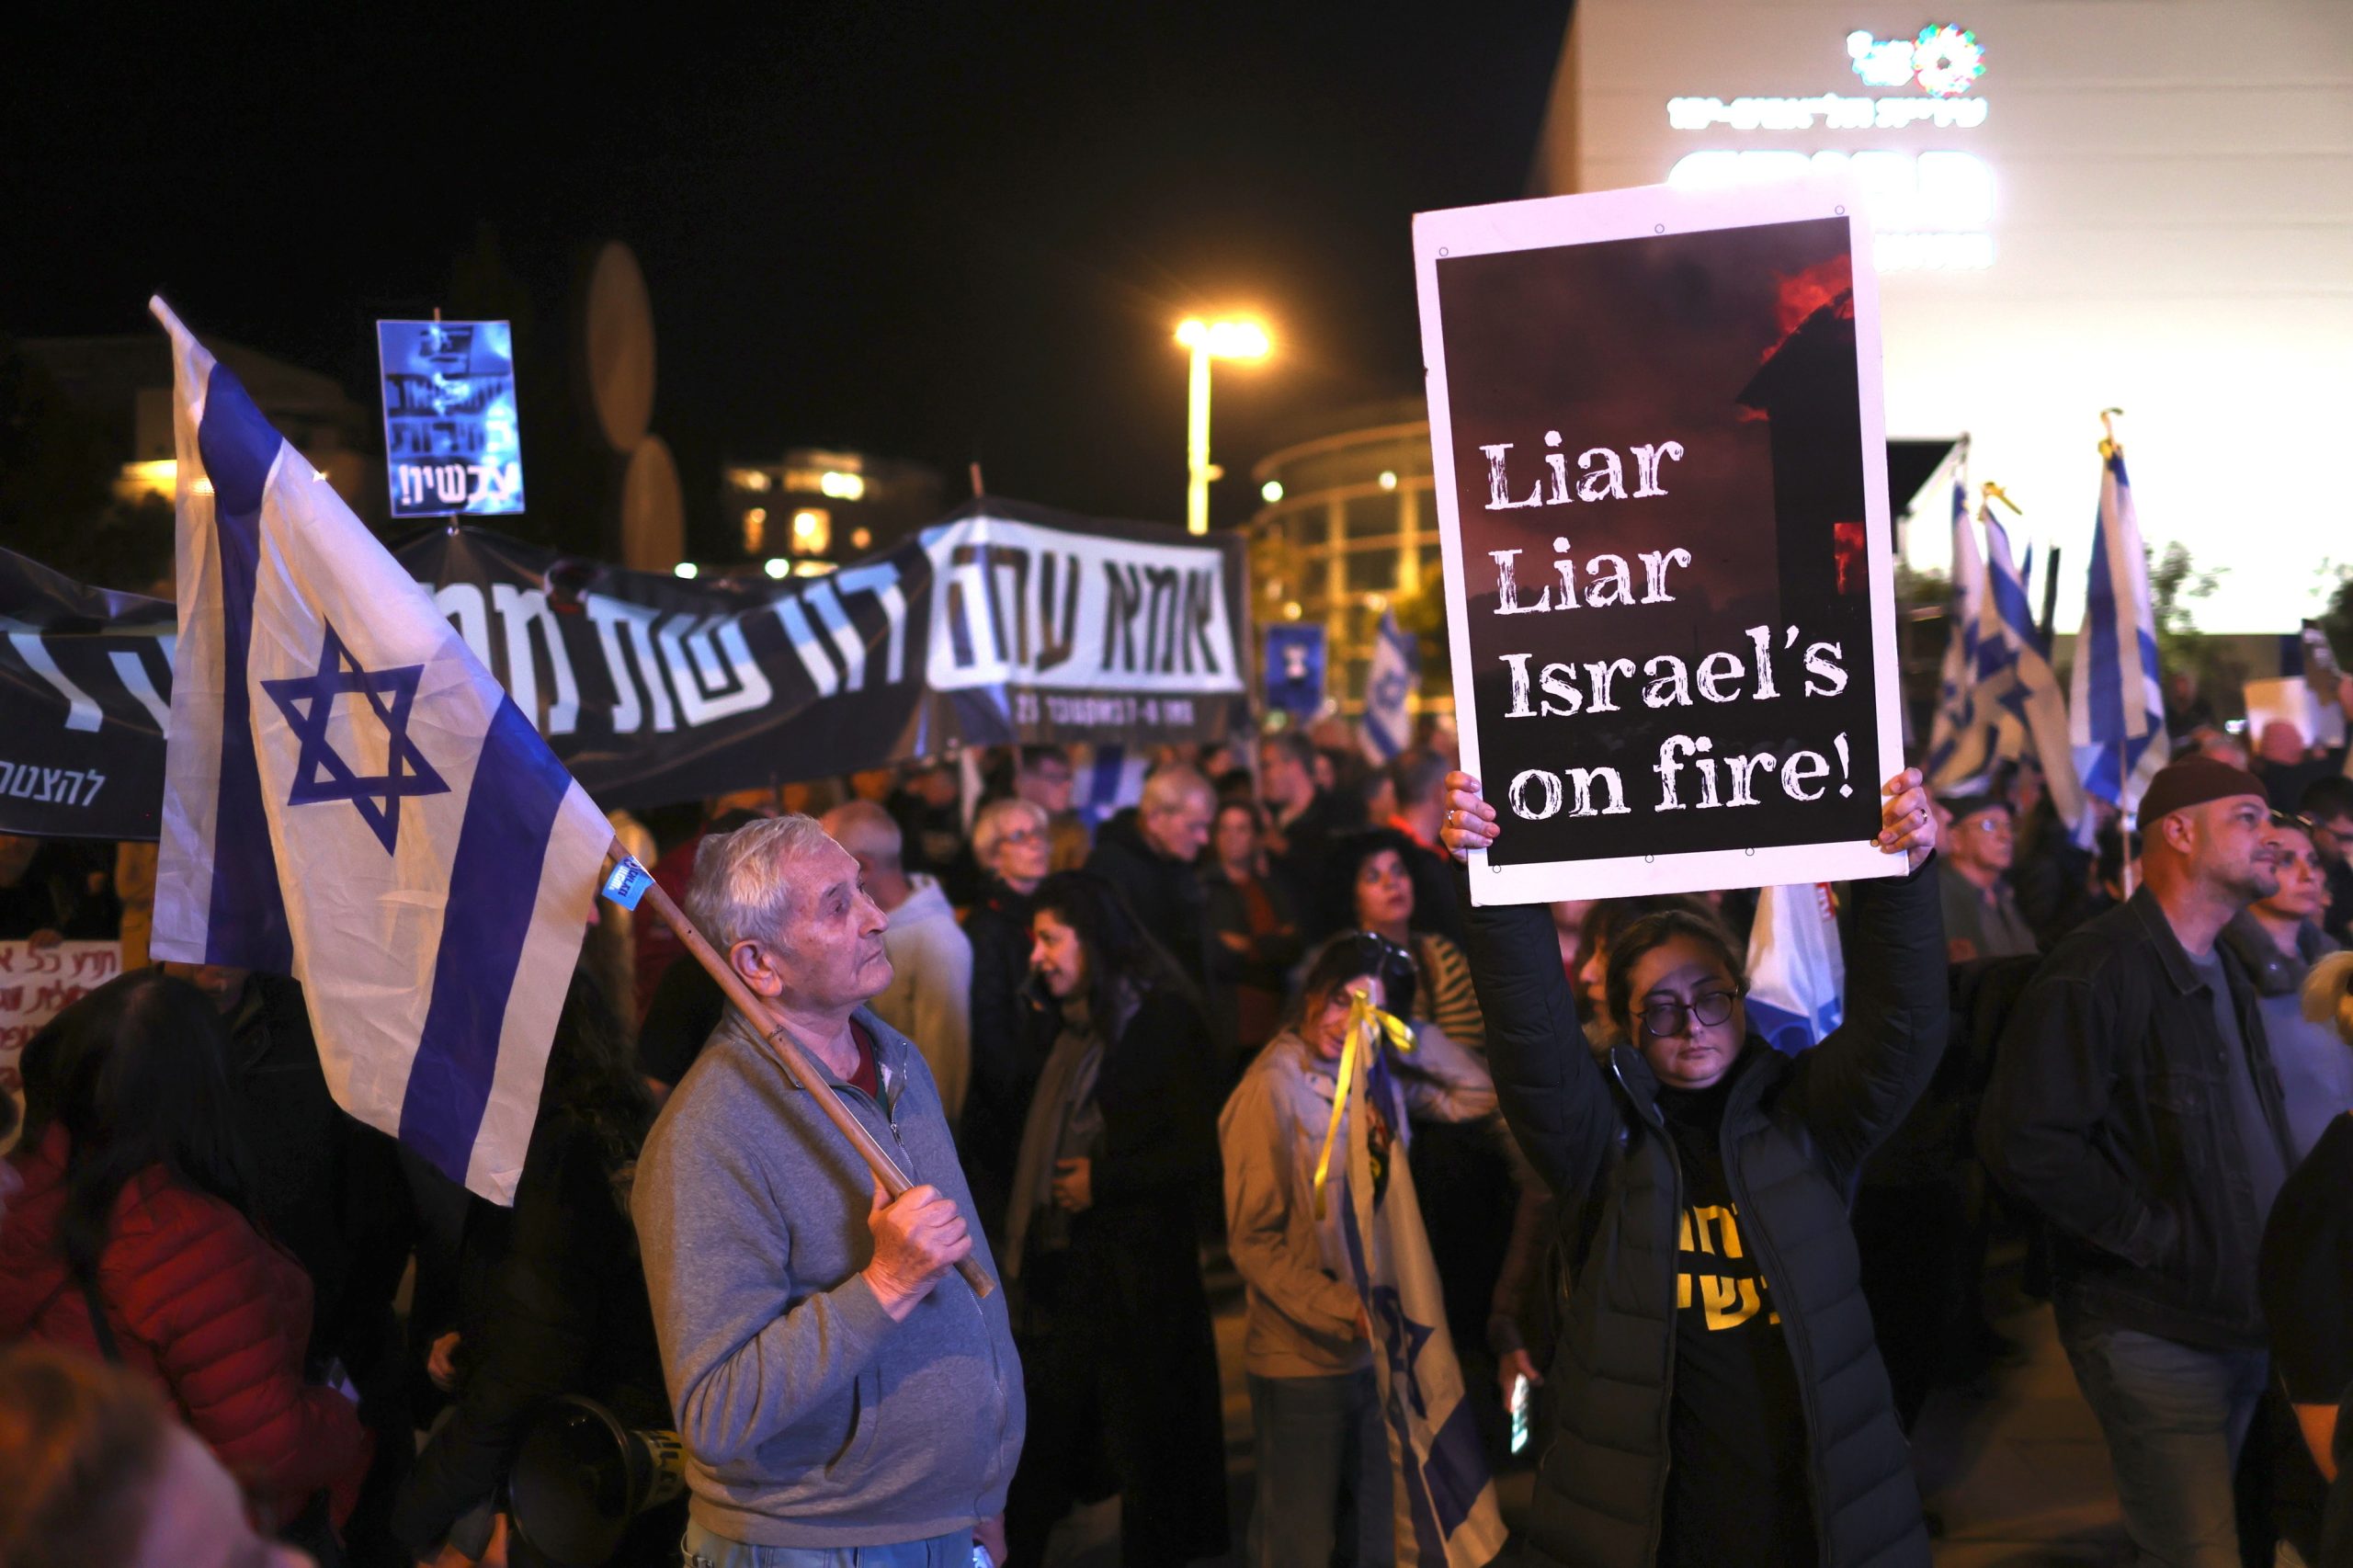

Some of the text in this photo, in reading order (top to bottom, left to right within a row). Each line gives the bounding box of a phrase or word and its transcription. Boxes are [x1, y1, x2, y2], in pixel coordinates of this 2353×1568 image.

[1479, 430, 1684, 510] Liar
[1100, 557, 1222, 674] אמא
[1488, 536, 1692, 616] Liar
[1498, 625, 1848, 719] Israel’s
[1508, 732, 1854, 821] on fire!
